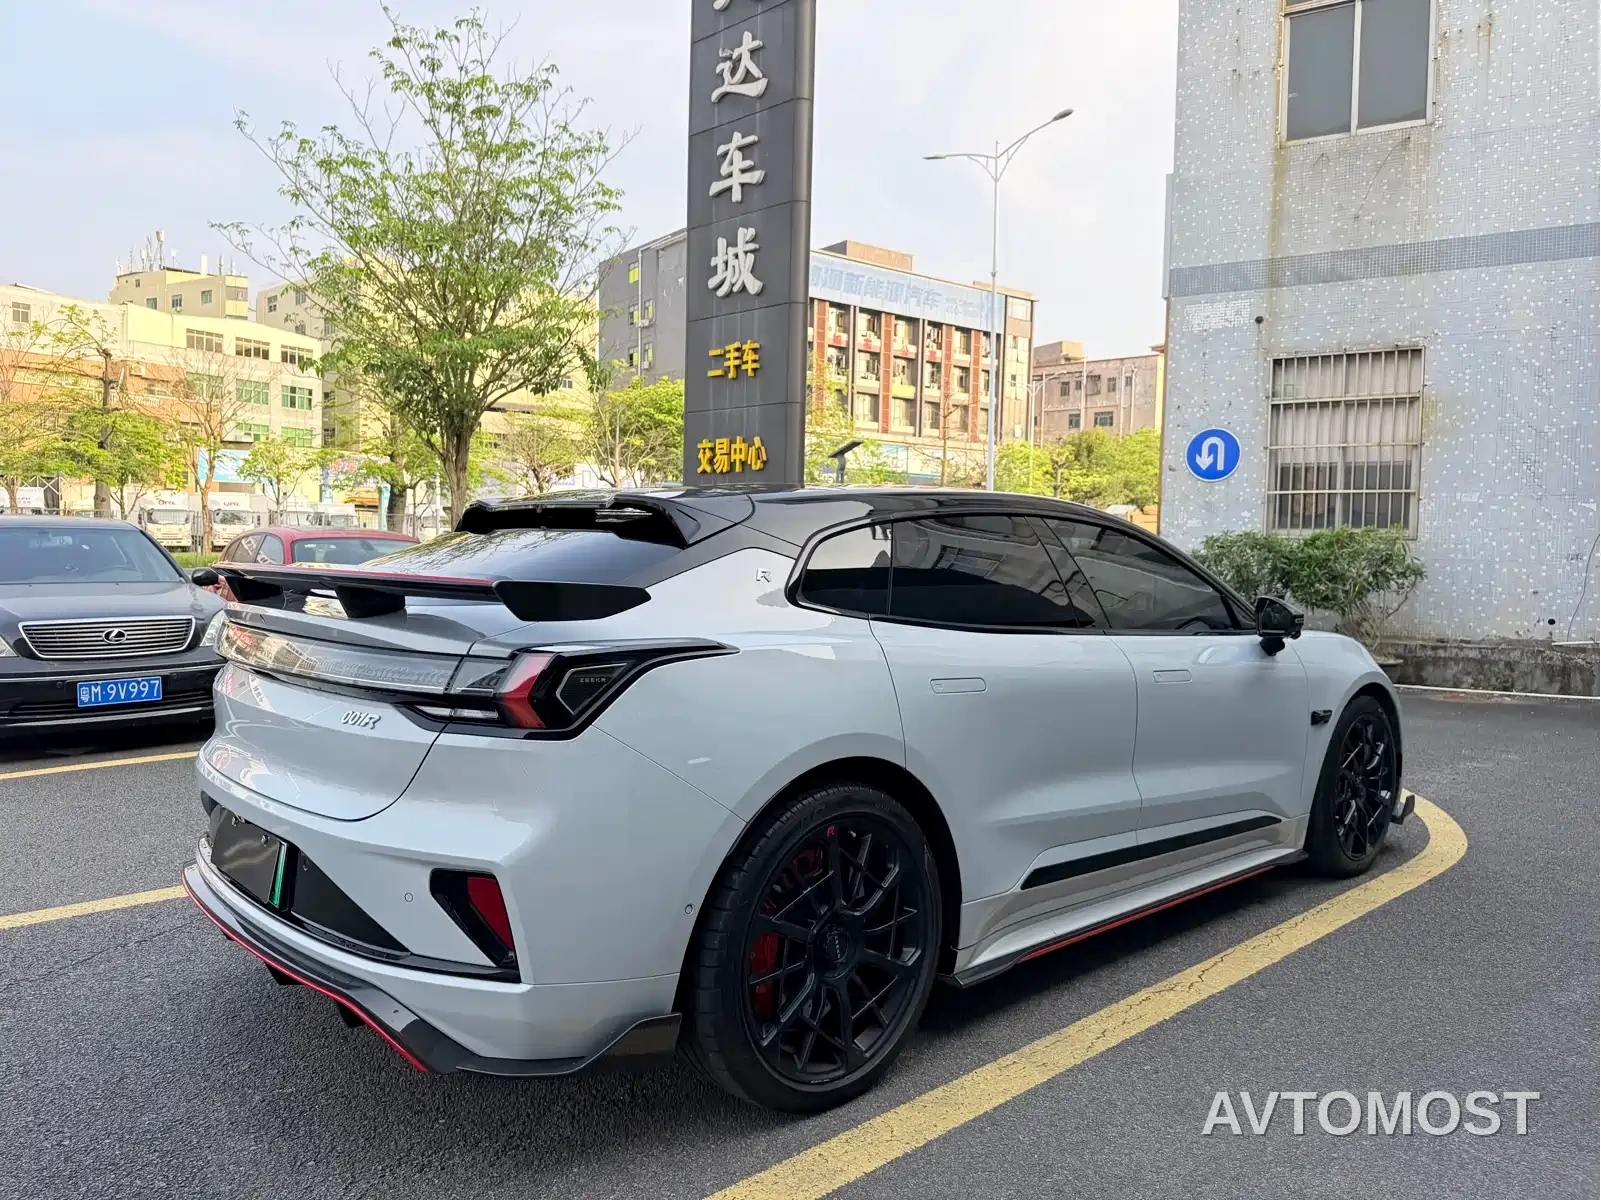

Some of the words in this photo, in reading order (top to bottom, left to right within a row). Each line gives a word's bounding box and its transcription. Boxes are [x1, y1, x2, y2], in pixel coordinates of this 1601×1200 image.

[708, 0, 769, 298] 达车城
[707, 340, 761, 379] 二手车
[697, 436, 768, 474] 交易中心
[341, 710, 382, 730] 001R
